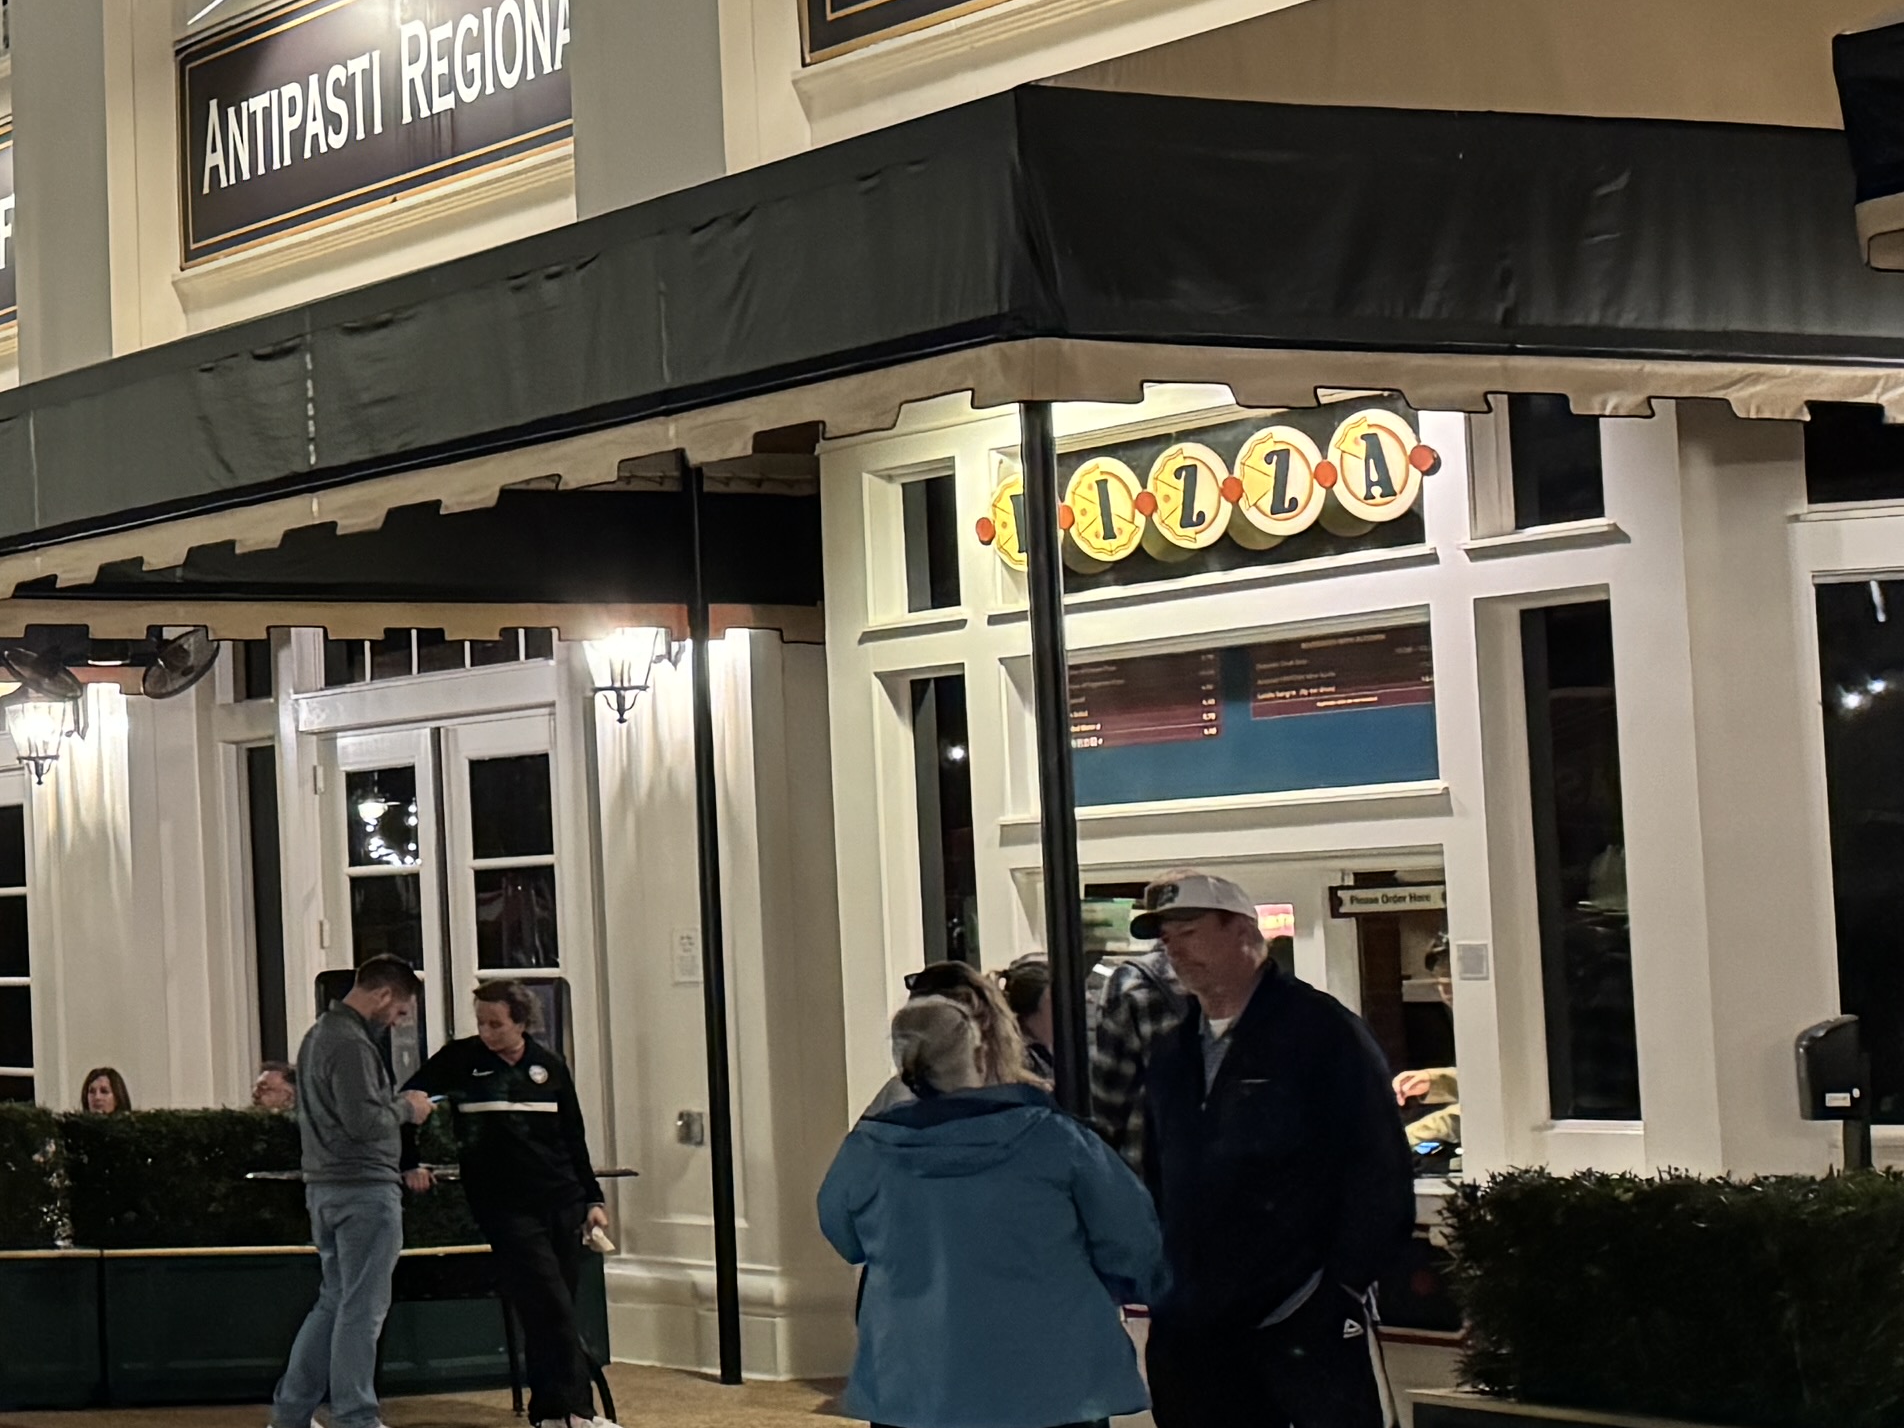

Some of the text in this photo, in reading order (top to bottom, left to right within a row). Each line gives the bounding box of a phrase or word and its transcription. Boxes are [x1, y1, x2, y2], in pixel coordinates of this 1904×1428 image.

[201, 49, 384, 195] ANTIPASTI
[1381, 893, 1407, 904] Order
[1409, 893, 1431, 903] Here
